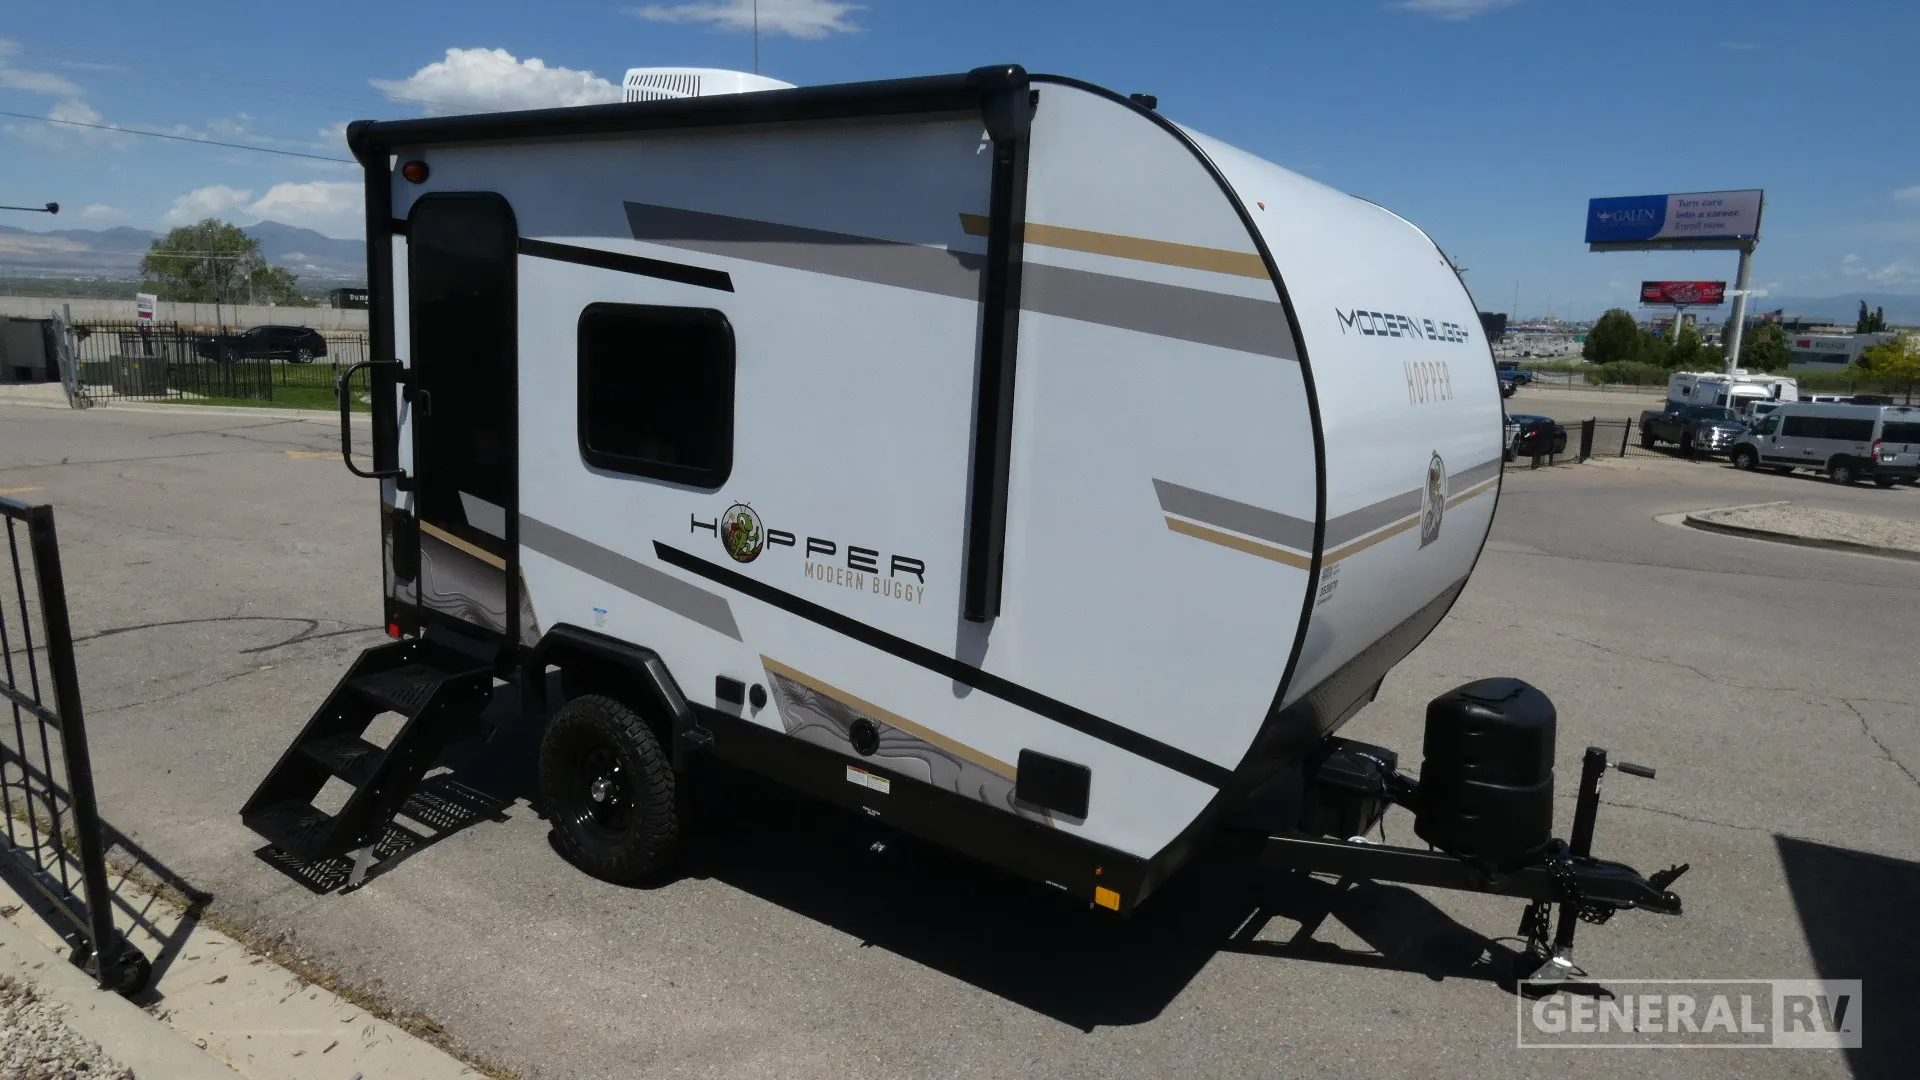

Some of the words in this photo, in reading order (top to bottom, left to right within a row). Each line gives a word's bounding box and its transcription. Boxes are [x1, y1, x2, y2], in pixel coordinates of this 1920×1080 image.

[1678, 199, 1699, 207] Turn
[1613, 209, 1655, 222] GALEN
[1676, 210, 1696, 218] into
[1675, 221, 1701, 230] Enroll
[1335, 307, 1424, 340] MODERN
[1423, 319, 1469, 343] BUGGY
[1403, 360, 1453, 405] HOPPER
[804, 561, 864, 590] MODERN
[873, 576, 924, 604] BUGGY
